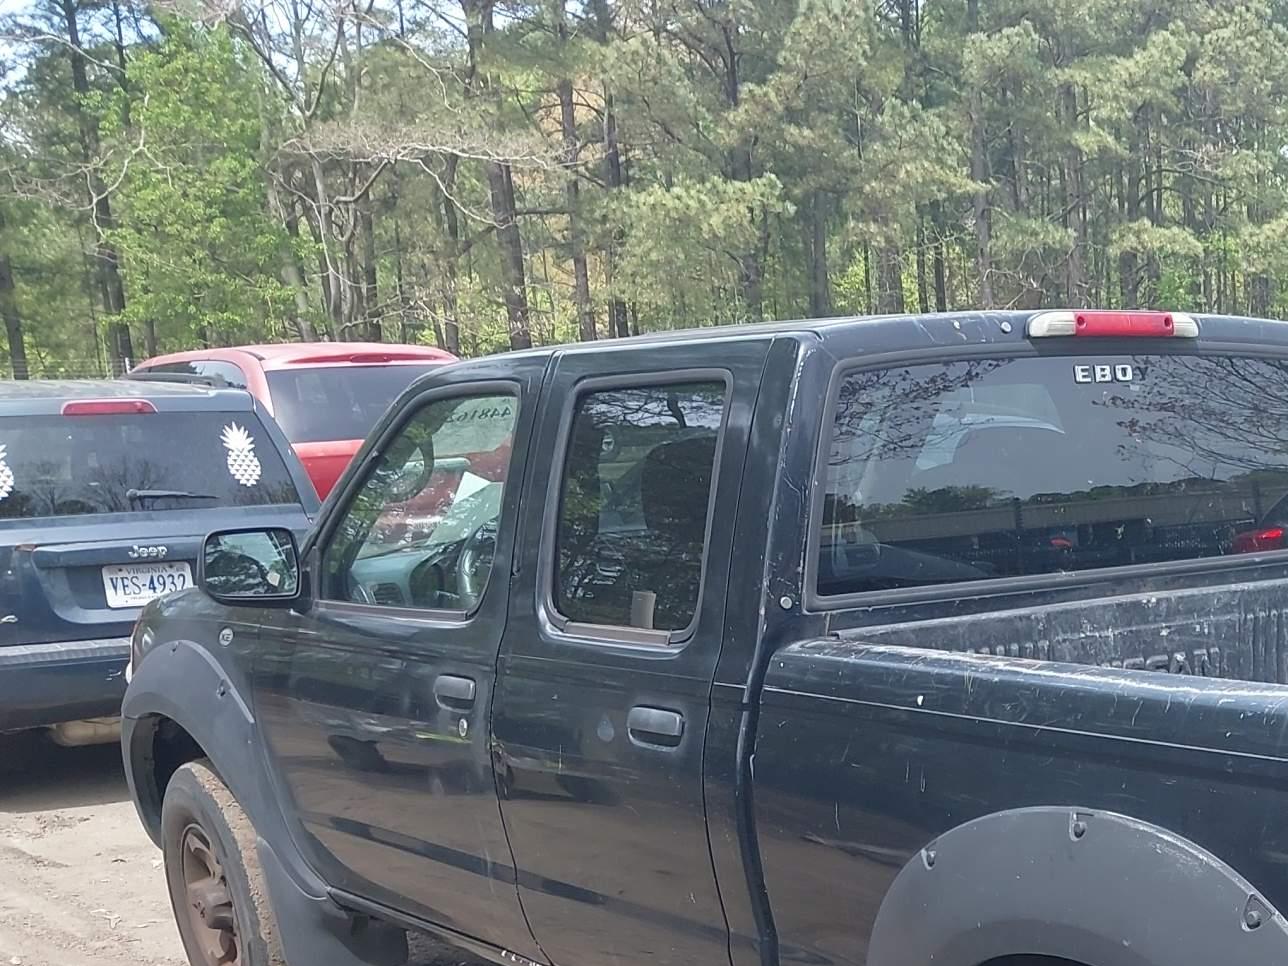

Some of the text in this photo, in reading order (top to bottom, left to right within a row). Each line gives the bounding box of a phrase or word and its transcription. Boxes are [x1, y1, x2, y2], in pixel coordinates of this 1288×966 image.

[128, 545, 168, 558] Jeep
[116, 567, 168, 575] VIRGINIA
[109, 573, 186, 597] VES-4932
